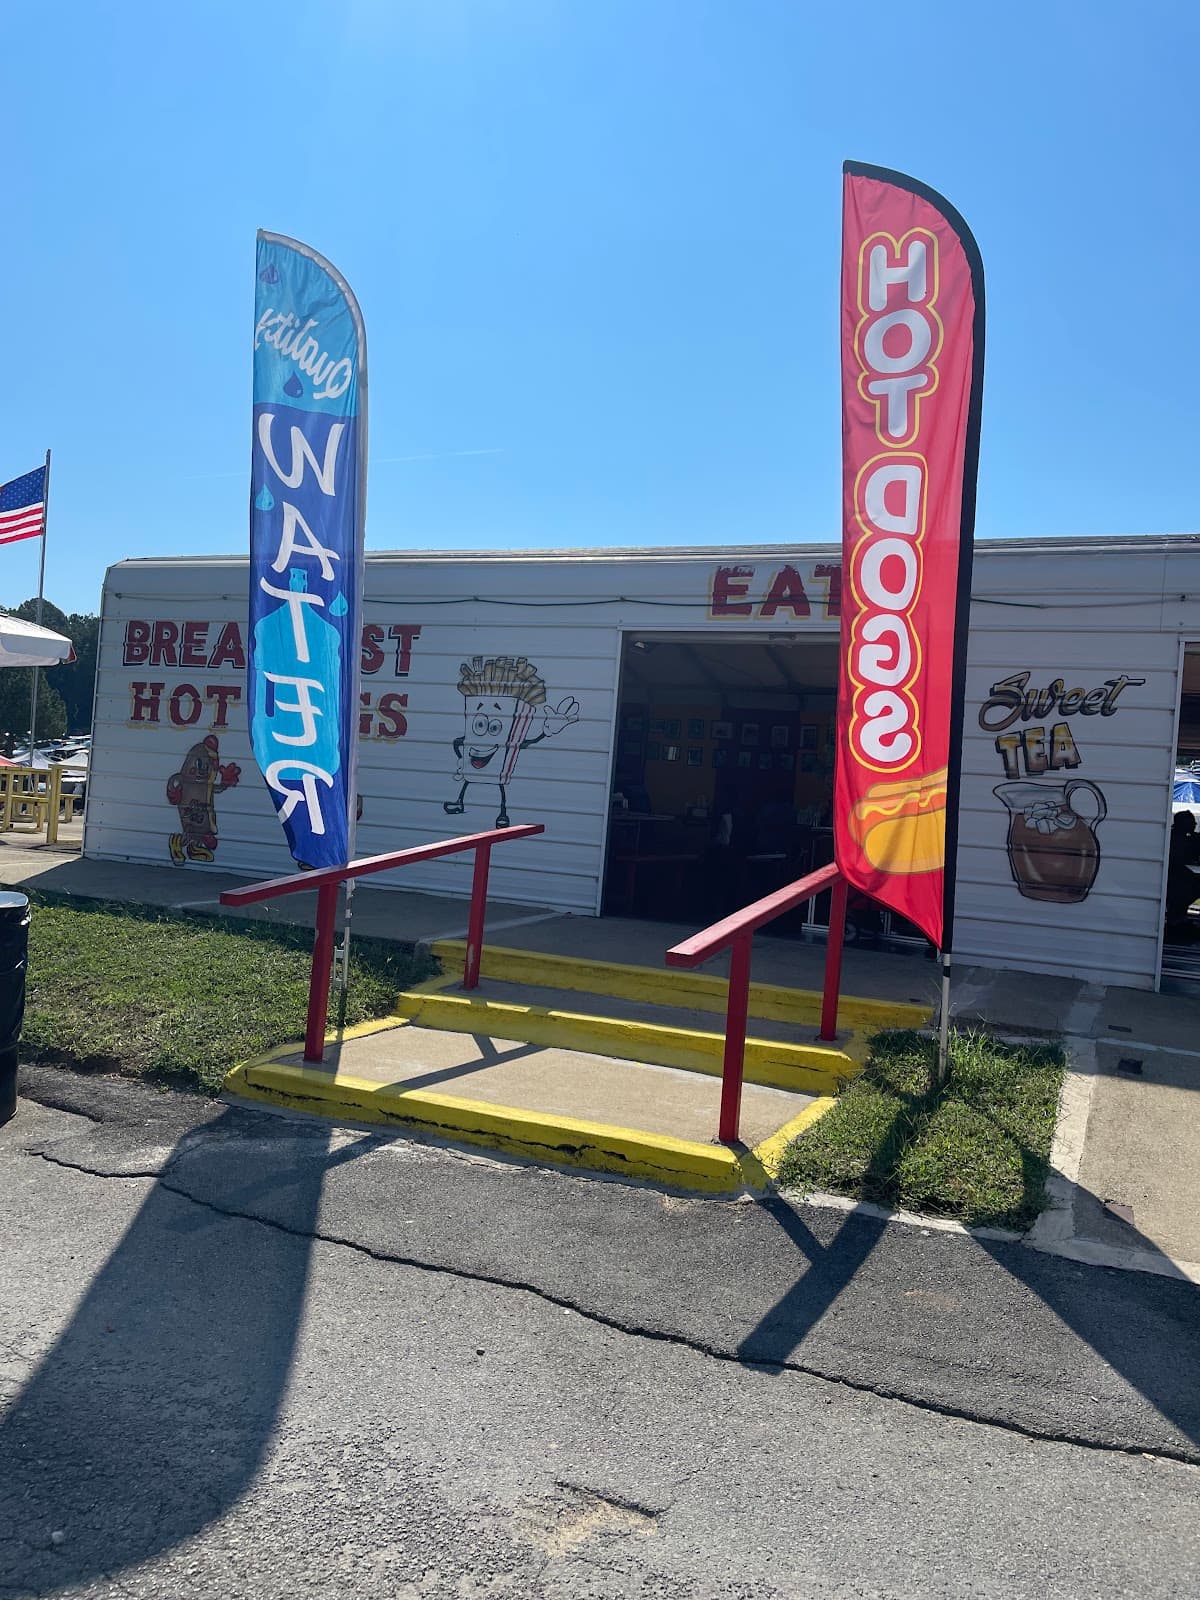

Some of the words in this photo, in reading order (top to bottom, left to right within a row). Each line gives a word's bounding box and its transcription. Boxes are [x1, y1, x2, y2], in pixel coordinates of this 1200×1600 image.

[122, 620, 422, 677] BREAST
[128, 681, 242, 730] HOT
[978, 671, 1146, 732] Sweet
[995, 722, 1082, 779] TEA
